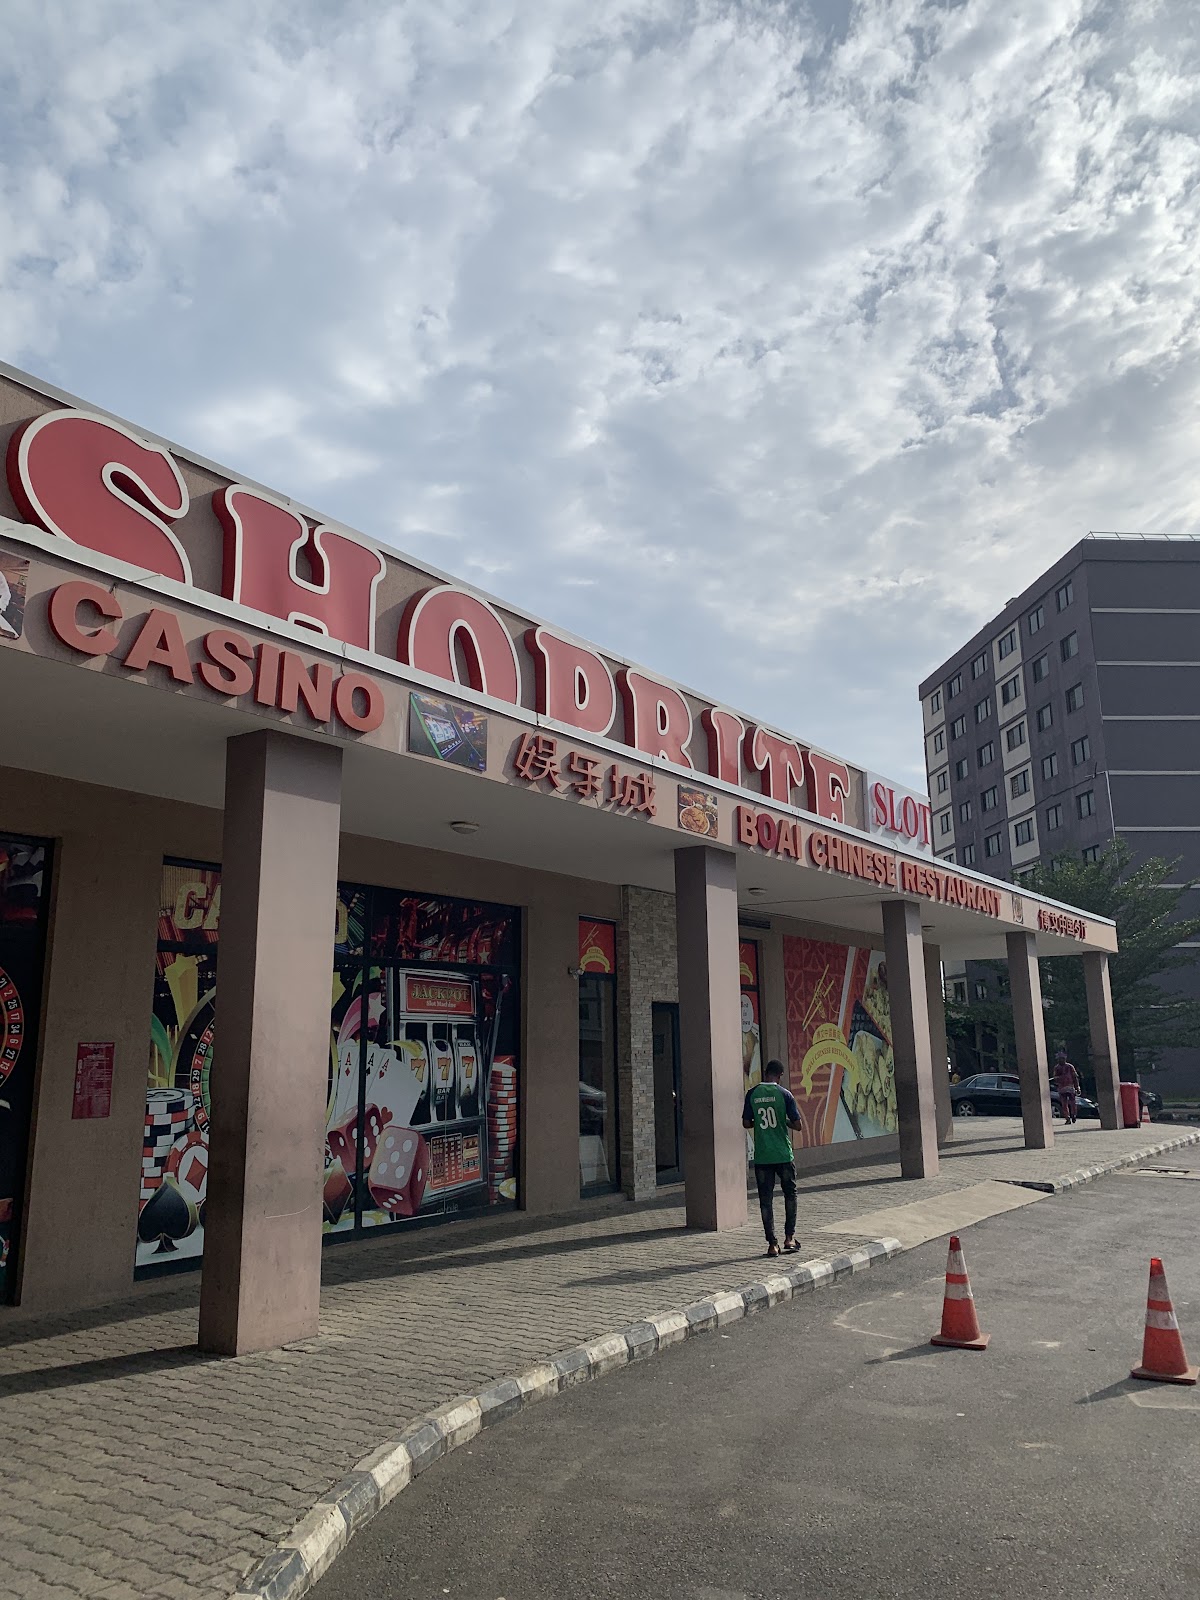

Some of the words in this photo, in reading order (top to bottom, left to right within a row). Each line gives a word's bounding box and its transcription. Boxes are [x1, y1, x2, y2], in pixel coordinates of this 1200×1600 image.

[48, 580, 385, 733] CASINO
[514, 732, 658, 817] 娱乐城
[871, 781, 931, 846] SLOT
[737, 805, 803, 859] BOAI
[809, 832, 897, 886] CHINESE
[901, 861, 1001, 917] RESTAURANT
[412, 984, 470, 1002] JACKPOT
[8, 999, 18, 1010] 25
[10, 1012, 20, 1020] 17
[10, 1024, 20, 1034] 34
[203, 1030, 214, 1042] 12
[5, 1048, 16, 1060] 27
[198, 1042, 207, 1055] 28
[344, 1052, 352, 1066] A
[368, 1052, 375, 1067] A
[381, 1058, 390, 1071] A
[410, 1058, 426, 1082] 7
[437, 1057, 452, 1081] 7
[461, 1055, 475, 1078] 7
[192, 1070, 200, 1082] 29
[192, 1083, 200, 1094] 18
[758, 1106, 777, 1130] 30
